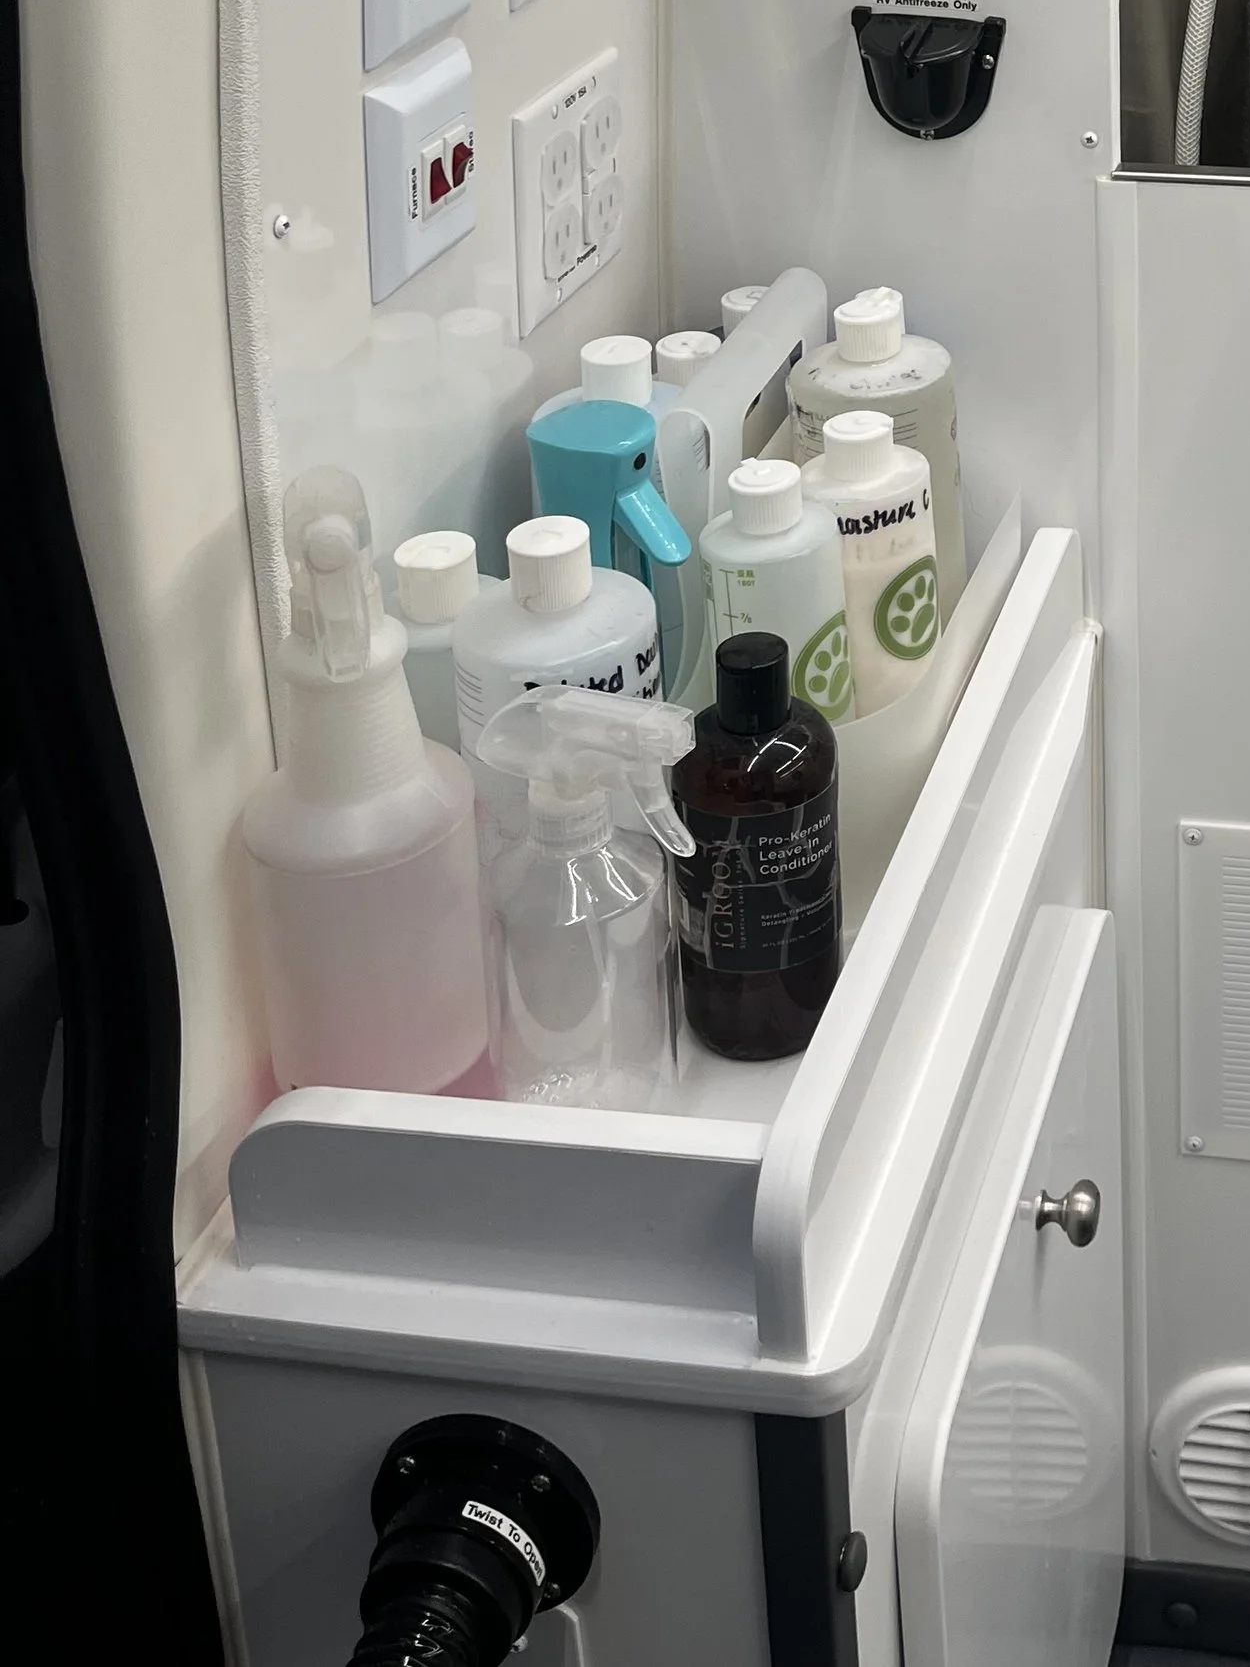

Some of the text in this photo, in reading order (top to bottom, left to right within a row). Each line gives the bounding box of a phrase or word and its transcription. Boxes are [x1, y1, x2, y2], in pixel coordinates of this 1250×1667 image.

[953, 0, 977, 12] Only
[759, 814, 831, 846] Pro-Keratin
[760, 837, 819, 861] Leave-In
[760, 841, 832, 874] Conditioner
[468, 1504, 543, 1578] Twist To Open
